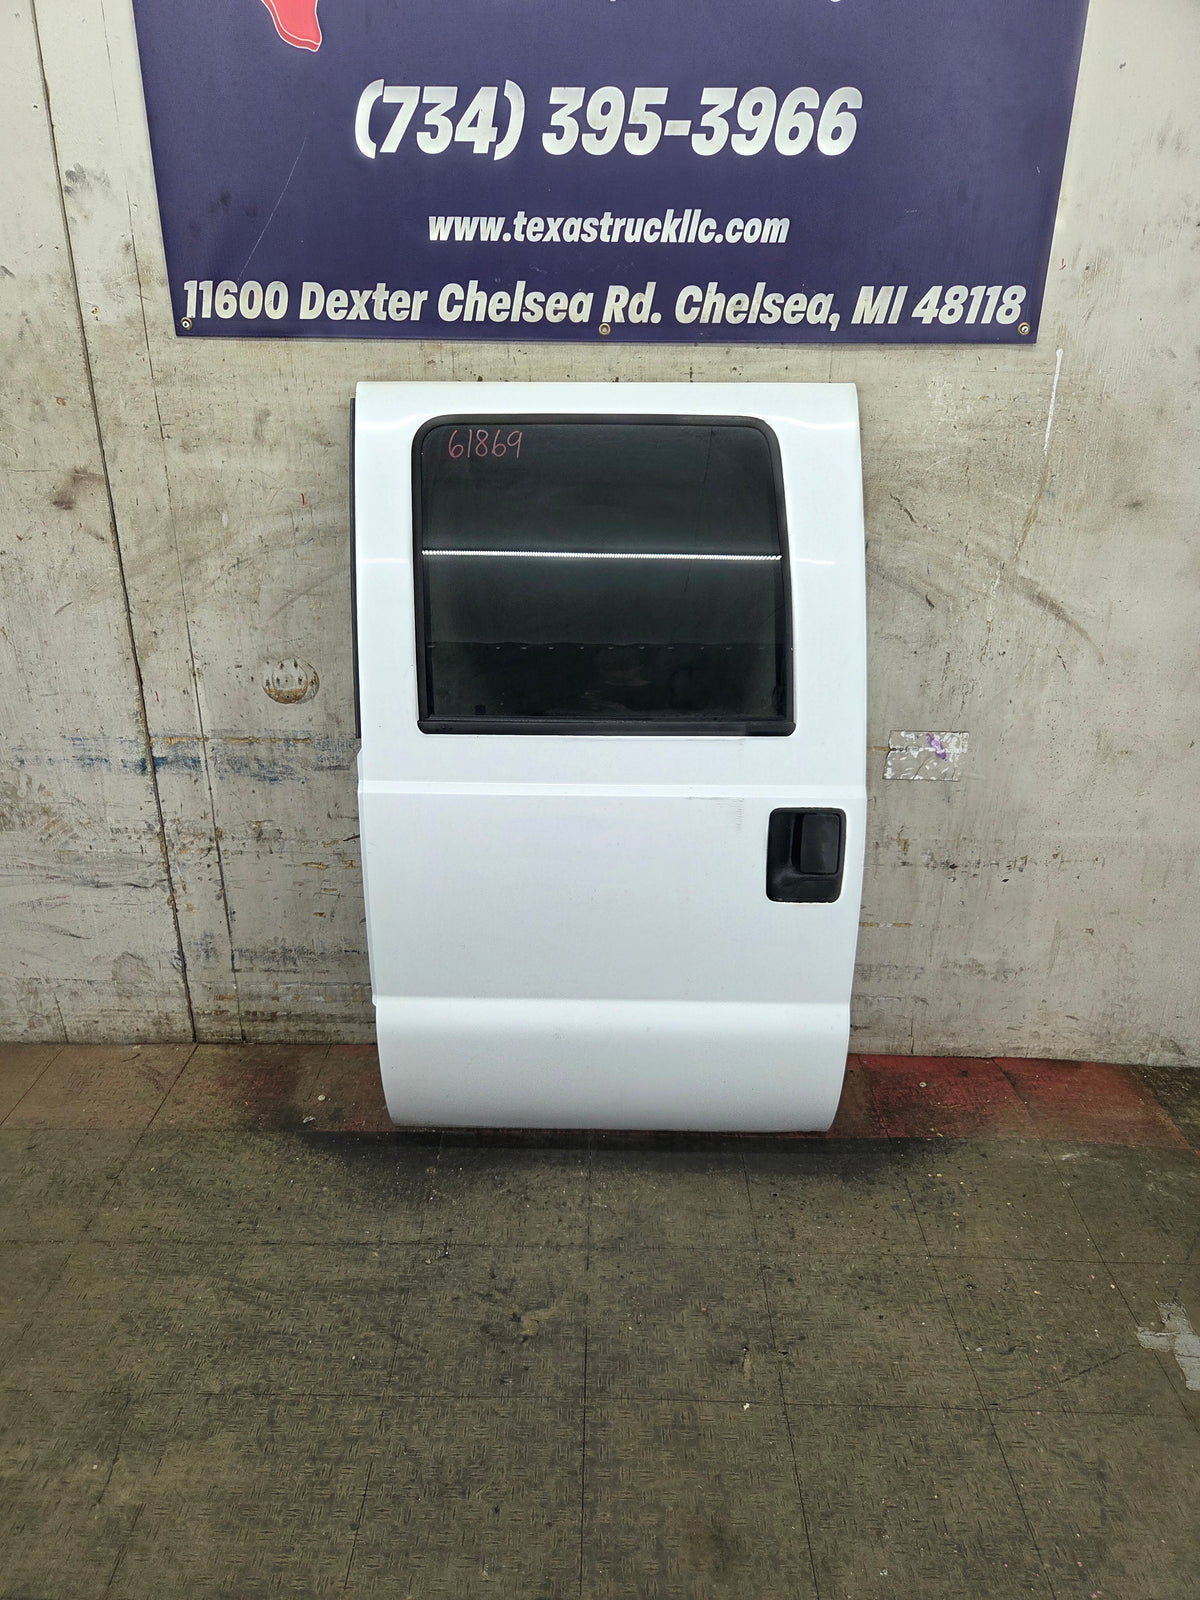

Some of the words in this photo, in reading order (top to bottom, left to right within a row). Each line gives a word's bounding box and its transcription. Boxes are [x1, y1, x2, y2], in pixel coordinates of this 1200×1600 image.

[354, 78, 526, 161] (734)
[541, 86, 863, 157] 395-3966
[428, 208, 790, 244] www.texastruckllc.com
[181, 279, 289, 324] 11600
[298, 280, 429, 322] Dexter
[437, 279, 595, 324] Chelsea
[601, 281, 662, 325] Rd.
[674, 281, 841, 332] Chelsea,
[850, 285, 909, 325] MI
[911, 284, 1027, 325] 48118
[448, 428, 523, 459] 61869
